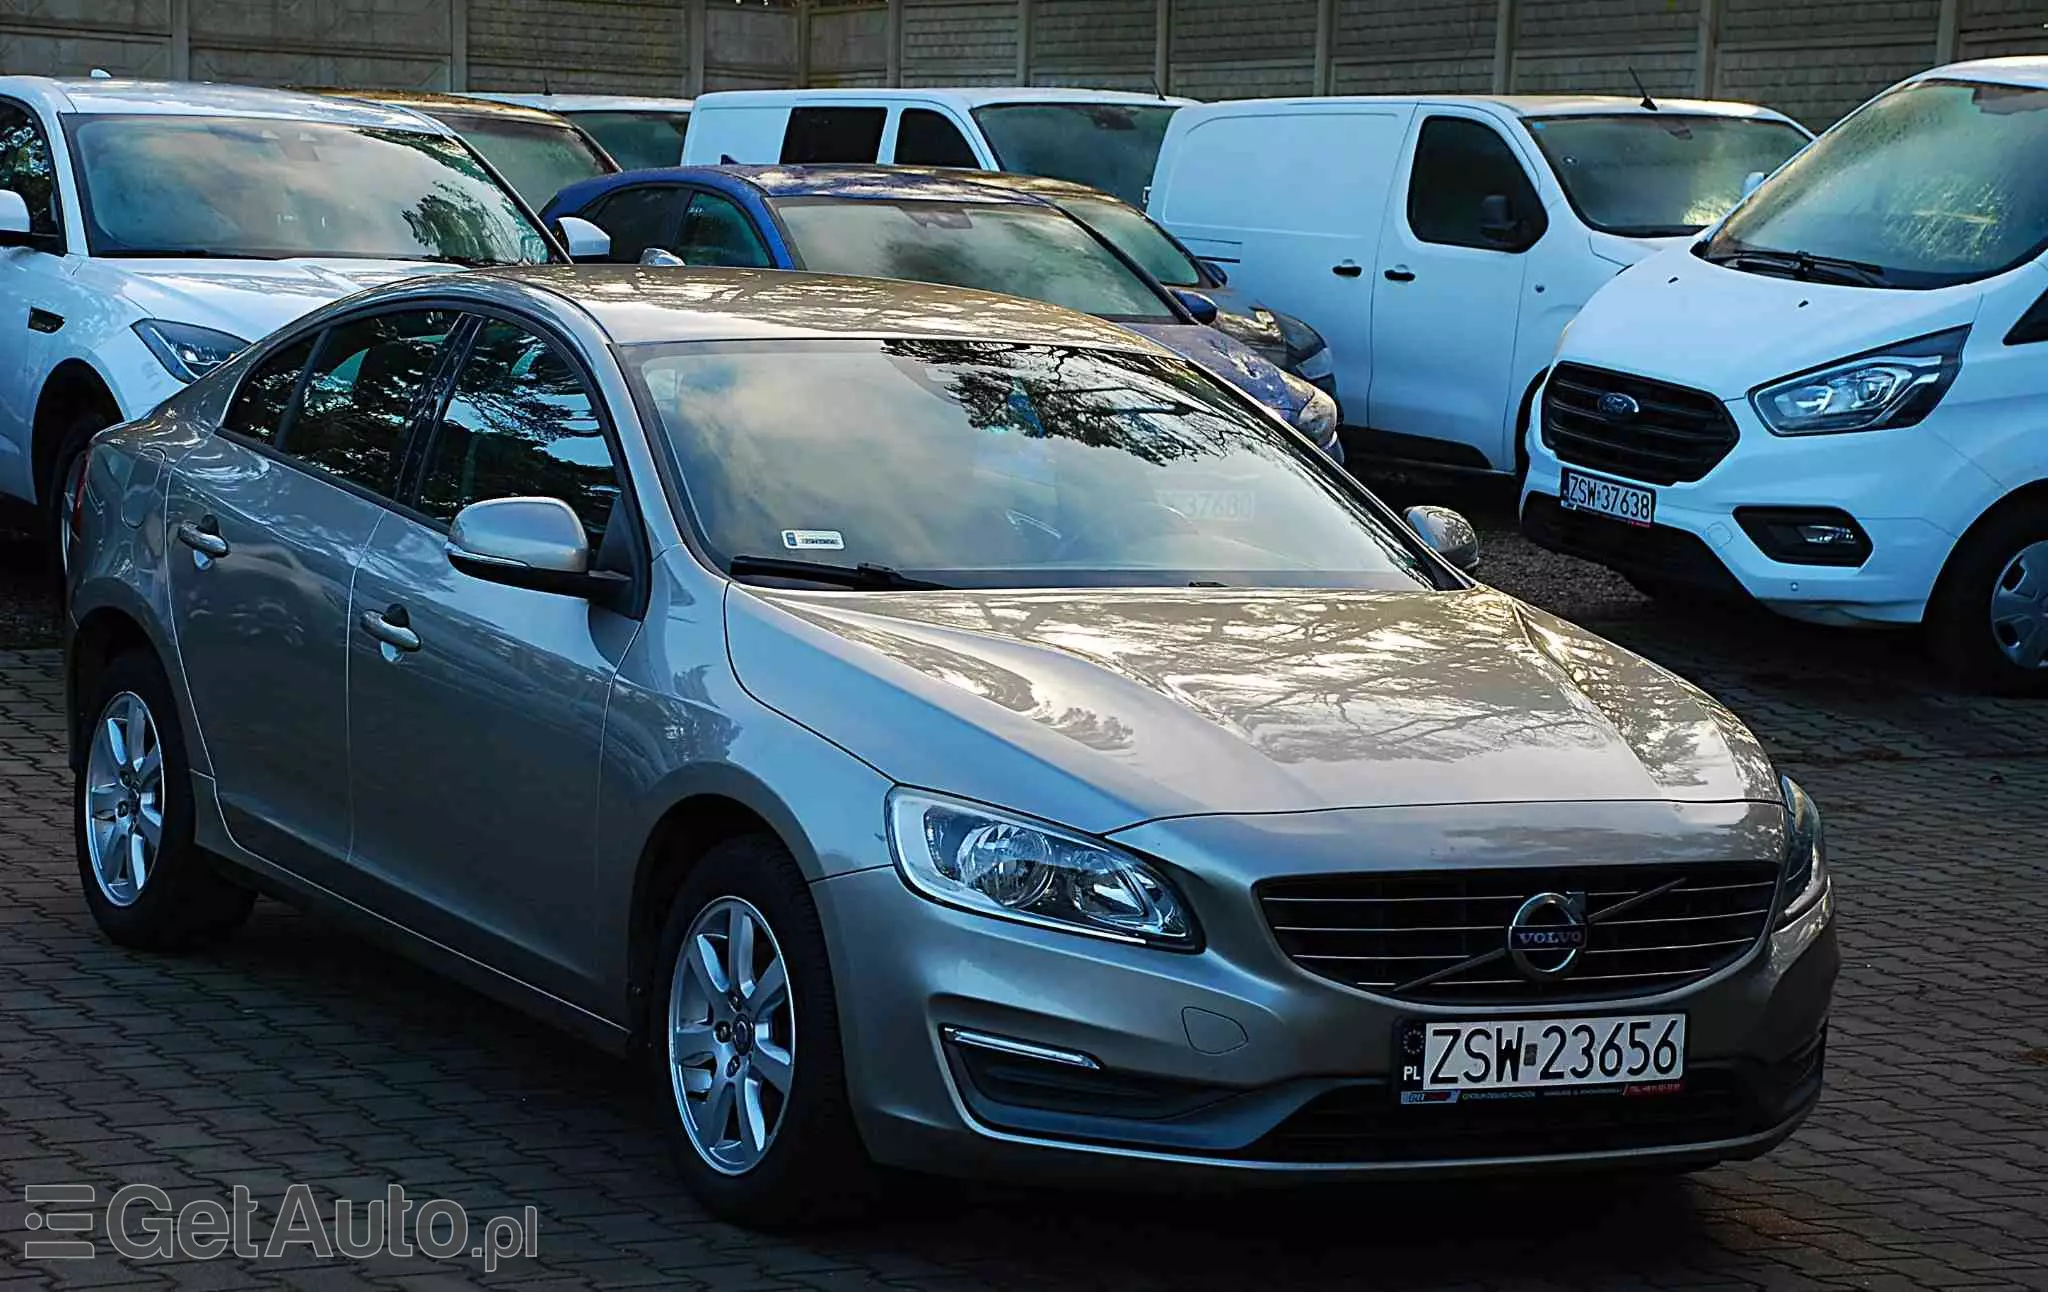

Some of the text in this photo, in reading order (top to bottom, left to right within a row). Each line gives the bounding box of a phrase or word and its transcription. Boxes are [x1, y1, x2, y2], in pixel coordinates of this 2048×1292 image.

[1570, 475, 1650, 520] ZSW 37638
[1517, 931, 1580, 944] VOLVO
[1429, 1019, 1678, 1084] ZSW 23656
[1403, 1065, 1421, 1081] PL
